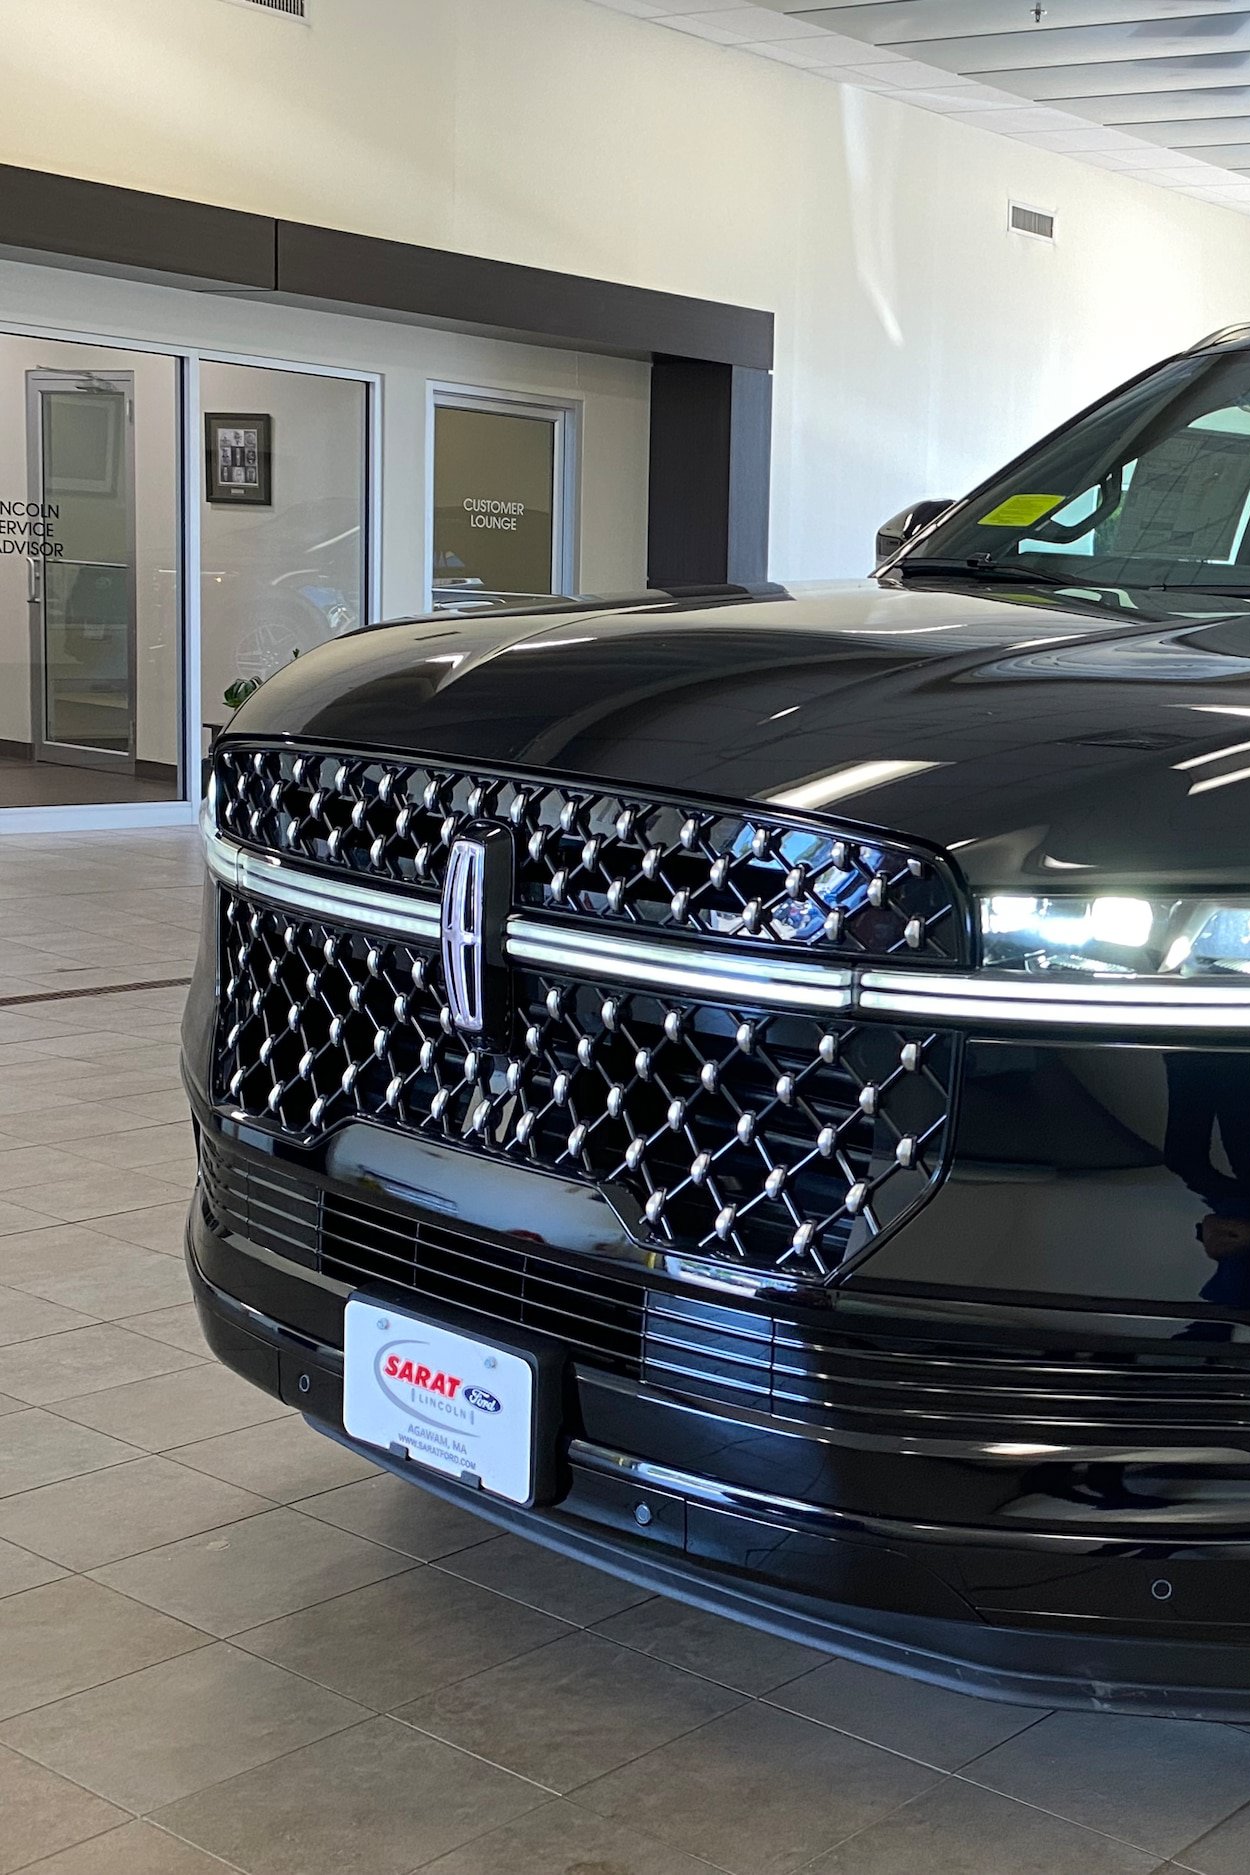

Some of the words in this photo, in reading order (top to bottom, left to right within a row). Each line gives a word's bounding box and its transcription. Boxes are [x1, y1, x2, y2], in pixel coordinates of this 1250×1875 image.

[463, 497, 525, 516] CUSTOMER
[470, 514, 517, 531] LOUNGE
[384, 1355, 461, 1399] SARAT
[418, 1393, 467, 1420] LINCOLN
[467, 1386, 500, 1412] Ford
[397, 1432, 477, 1470] WWW.SARATFORD.COM
[452, 1440, 468, 1455] MA
